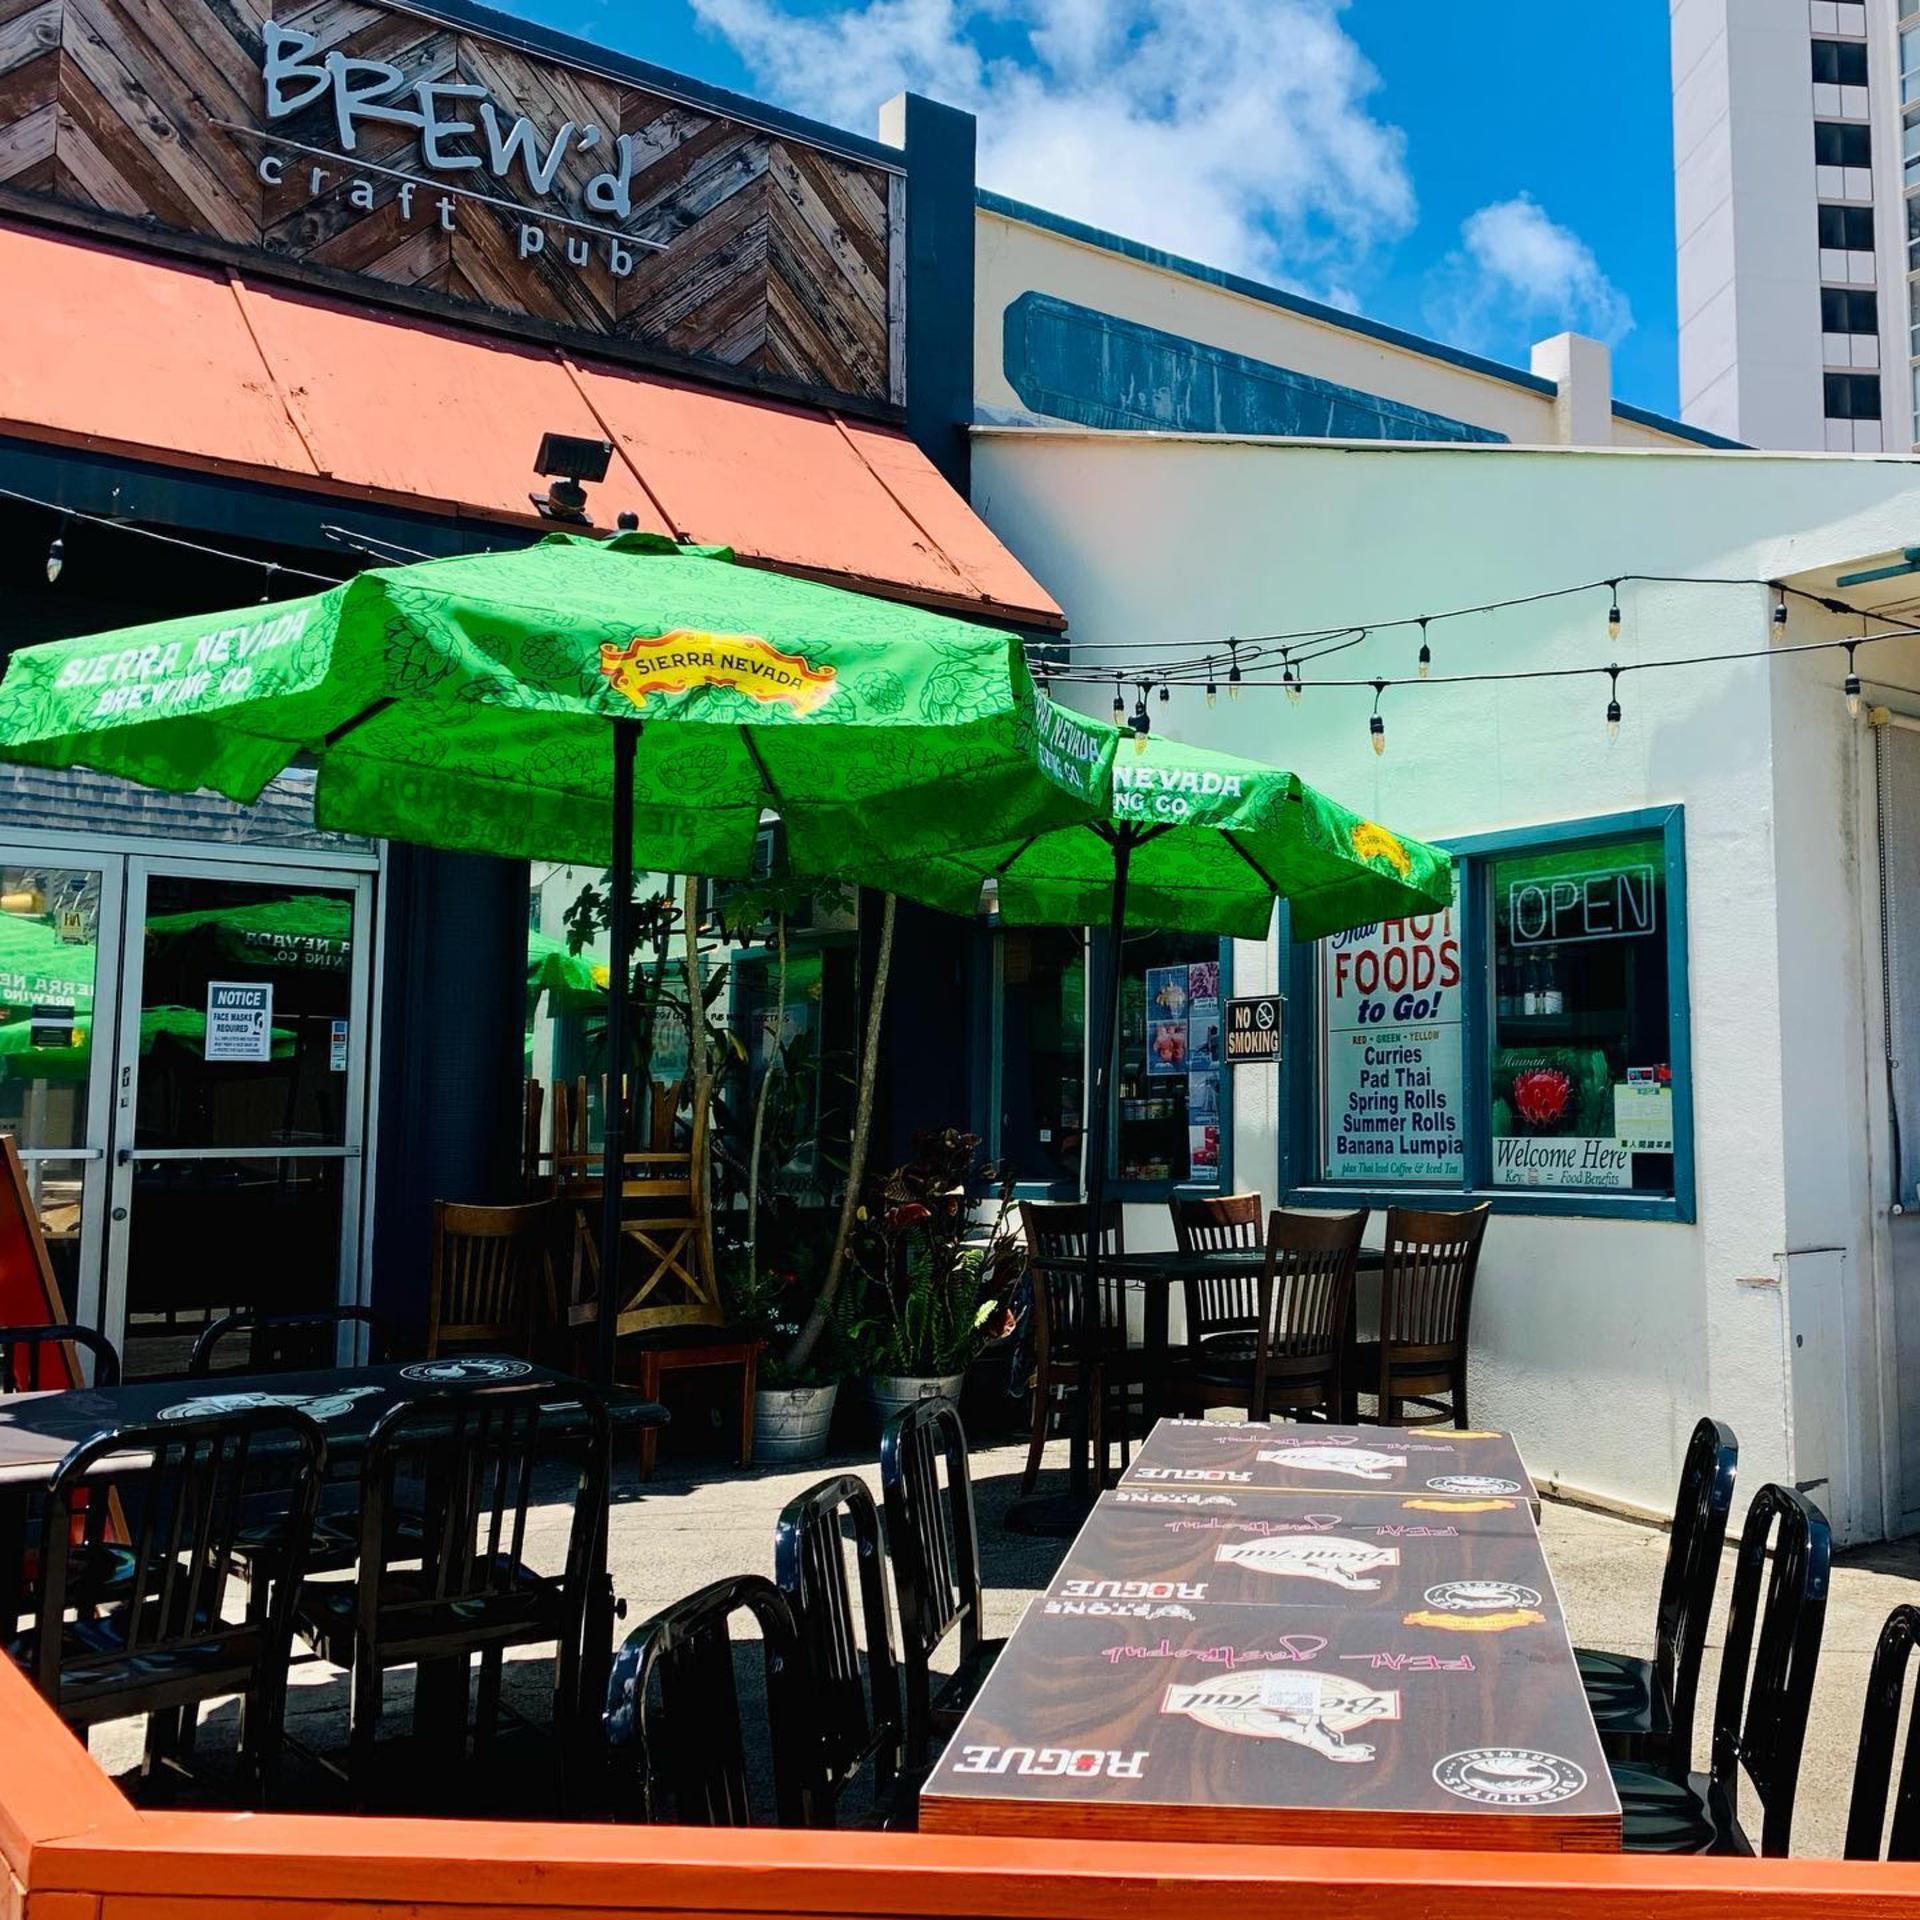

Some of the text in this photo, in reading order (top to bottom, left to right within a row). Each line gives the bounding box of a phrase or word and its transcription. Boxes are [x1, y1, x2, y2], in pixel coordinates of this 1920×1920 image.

[263, 20, 632, 219] BREW'd
[258, 154, 635, 278] craft pub
[55, 608, 312, 688] SIERRA NEVADA
[635, 652, 804, 690] SIERRA NEVADA
[1050, 715, 1104, 764] NEVADA
[1112, 767, 1242, 797] NEVADA
[1516, 871, 1648, 939] OPEN
[1334, 939, 1461, 999] FOODS
[217, 990, 261, 1006] NOTICE
[1357, 991, 1443, 1024] to Go!
[213, 1012, 252, 1022] FACE MASKS
[216, 1024, 249, 1033] REQUIRED
[1235, 1006, 1251, 1029] NO
[1228, 1030, 1279, 1054] SMOKING
[1352, 1030, 1440, 1045] RED GREEN YELLOW
[1364, 1045, 1423, 1066] Curries
[1360, 1066, 1431, 1089] Pad Thai
[1349, 1089, 1447, 1115] Spring Rolls
[1343, 1111, 1457, 1133] Summer Rolls
[1336, 1135, 1464, 1159] Banana Lumpia
[1497, 1139, 1628, 1170] Welcome Here
[1390, 1162, 1413, 1178] Coffee
[1426, 1162, 1442, 1174] Iced
[1560, 1170, 1583, 1185] Food
[1584, 1169, 1620, 1187] Benefits
[1134, 1467, 1254, 1483] ROGUE
[1060, 1579, 1210, 1600] ROGUE
[1043, 1601, 1151, 1617] STONE
[1319, 1696, 1389, 1714] Be
[952, 1745, 1150, 1779] ROGUE
[1443, 1777, 1579, 1803] DESCHUTES
